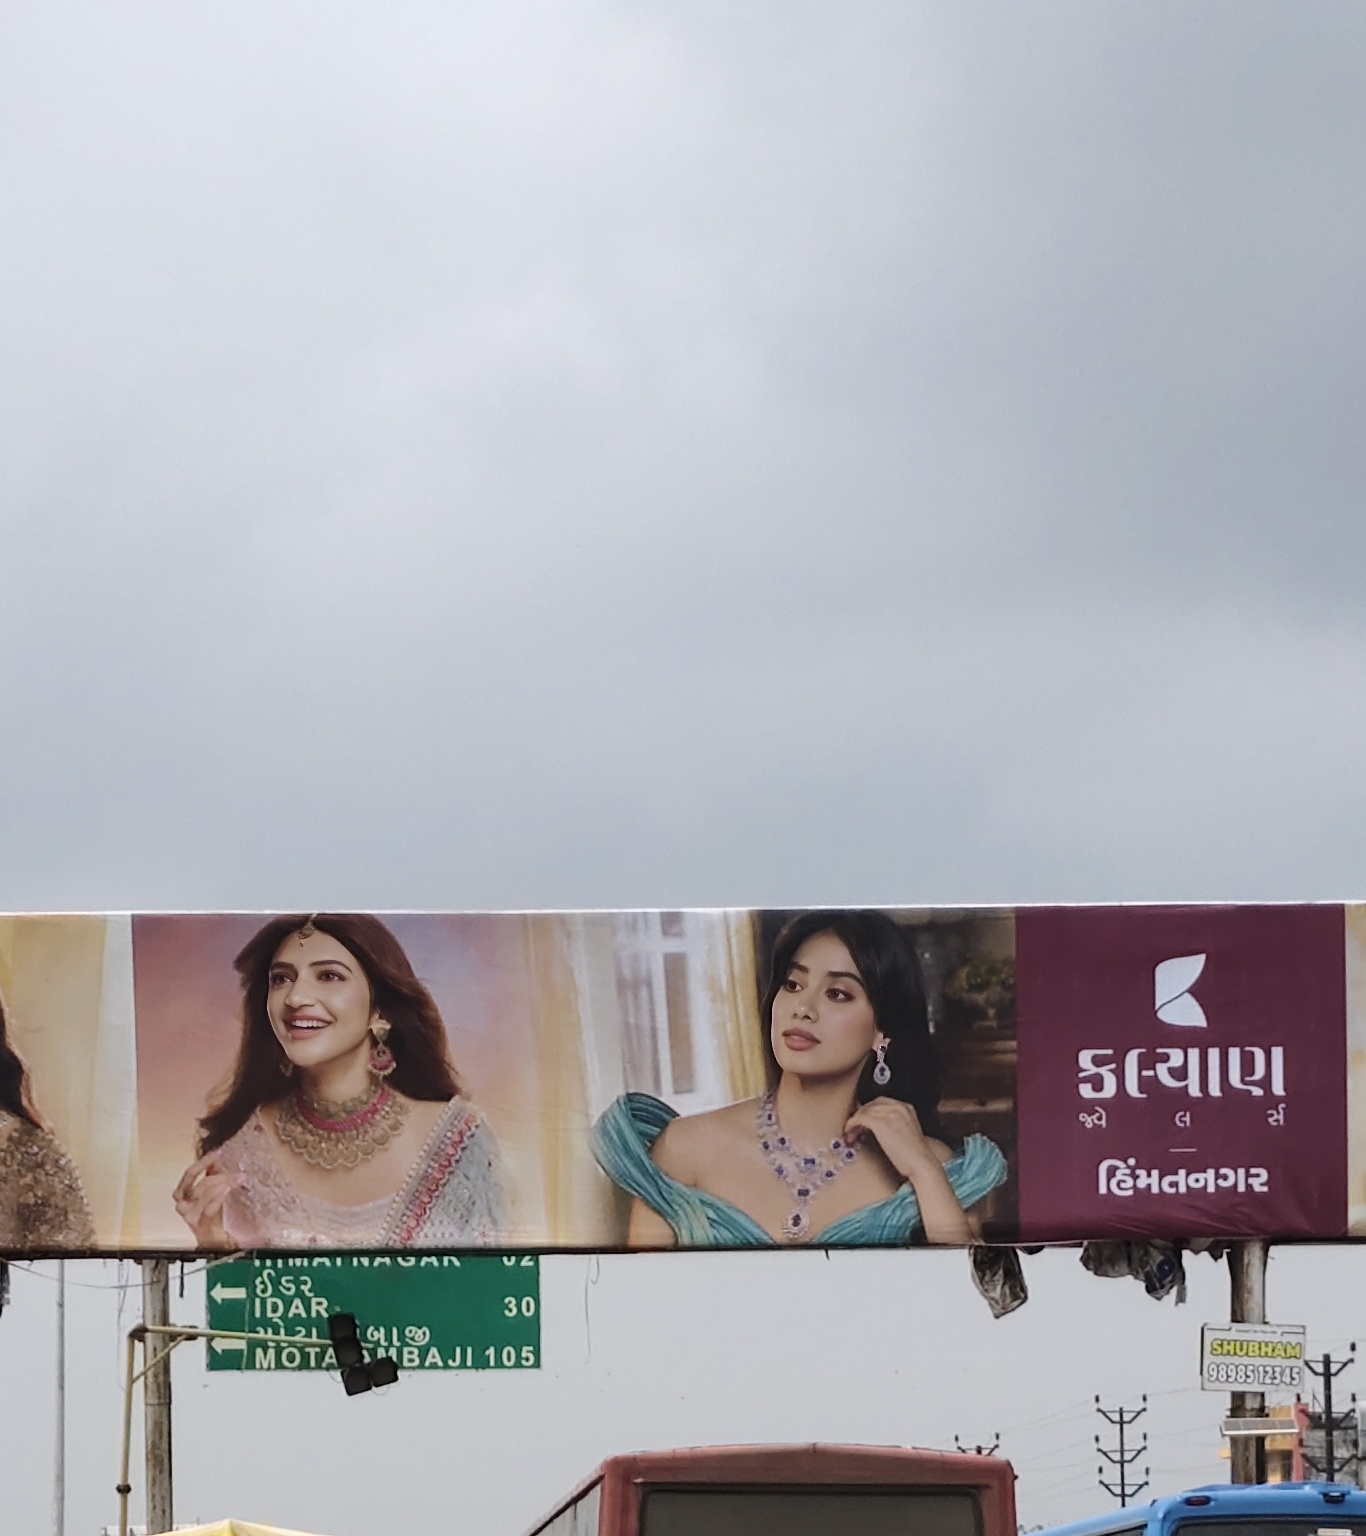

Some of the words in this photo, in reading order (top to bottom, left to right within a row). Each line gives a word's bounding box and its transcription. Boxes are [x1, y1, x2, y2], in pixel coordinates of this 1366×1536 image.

[1077, 1046, 1287, 1099] કલ્યાણ
[1098, 1157, 1269, 1196] હિંમતનગર
[254, 1297, 329, 1318] IDAR
[503, 1297, 535, 1318] 30
[485, 1347, 535, 1367] 105
[1210, 1339, 1302, 1360] SHUBHAM
[1208, 1361, 1255, 1384] 98985
[1256, 1364, 1302, 1386] 12345
